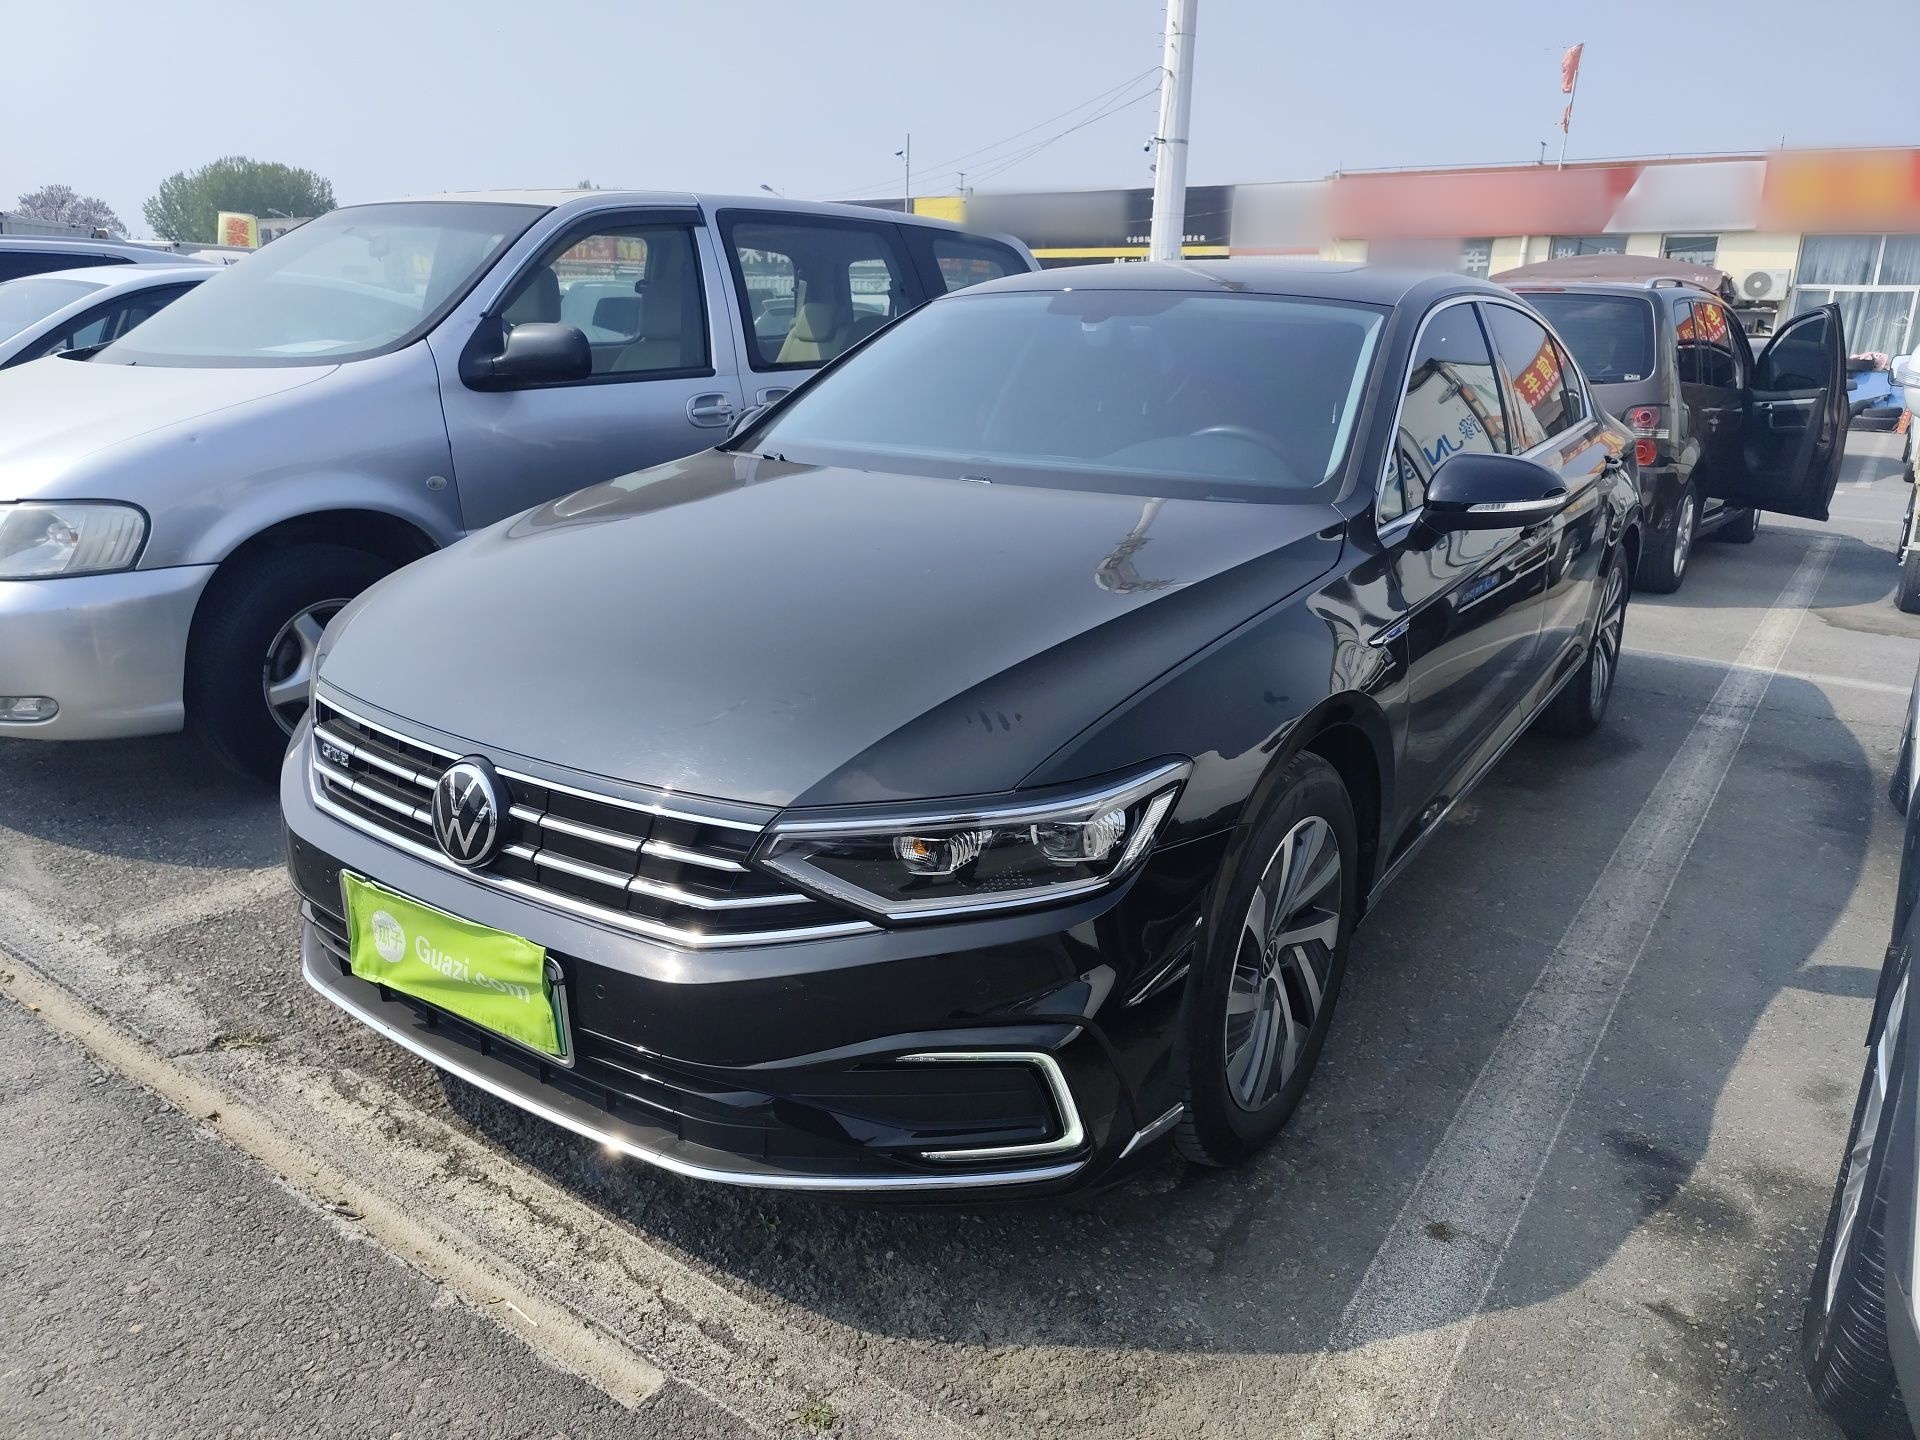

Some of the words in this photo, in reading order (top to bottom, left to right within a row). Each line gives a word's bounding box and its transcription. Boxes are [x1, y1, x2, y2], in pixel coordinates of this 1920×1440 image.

[322, 742, 349, 768] GTE
[434, 763, 497, 862] VW
[415, 935, 531, 1004] Guazi.com
